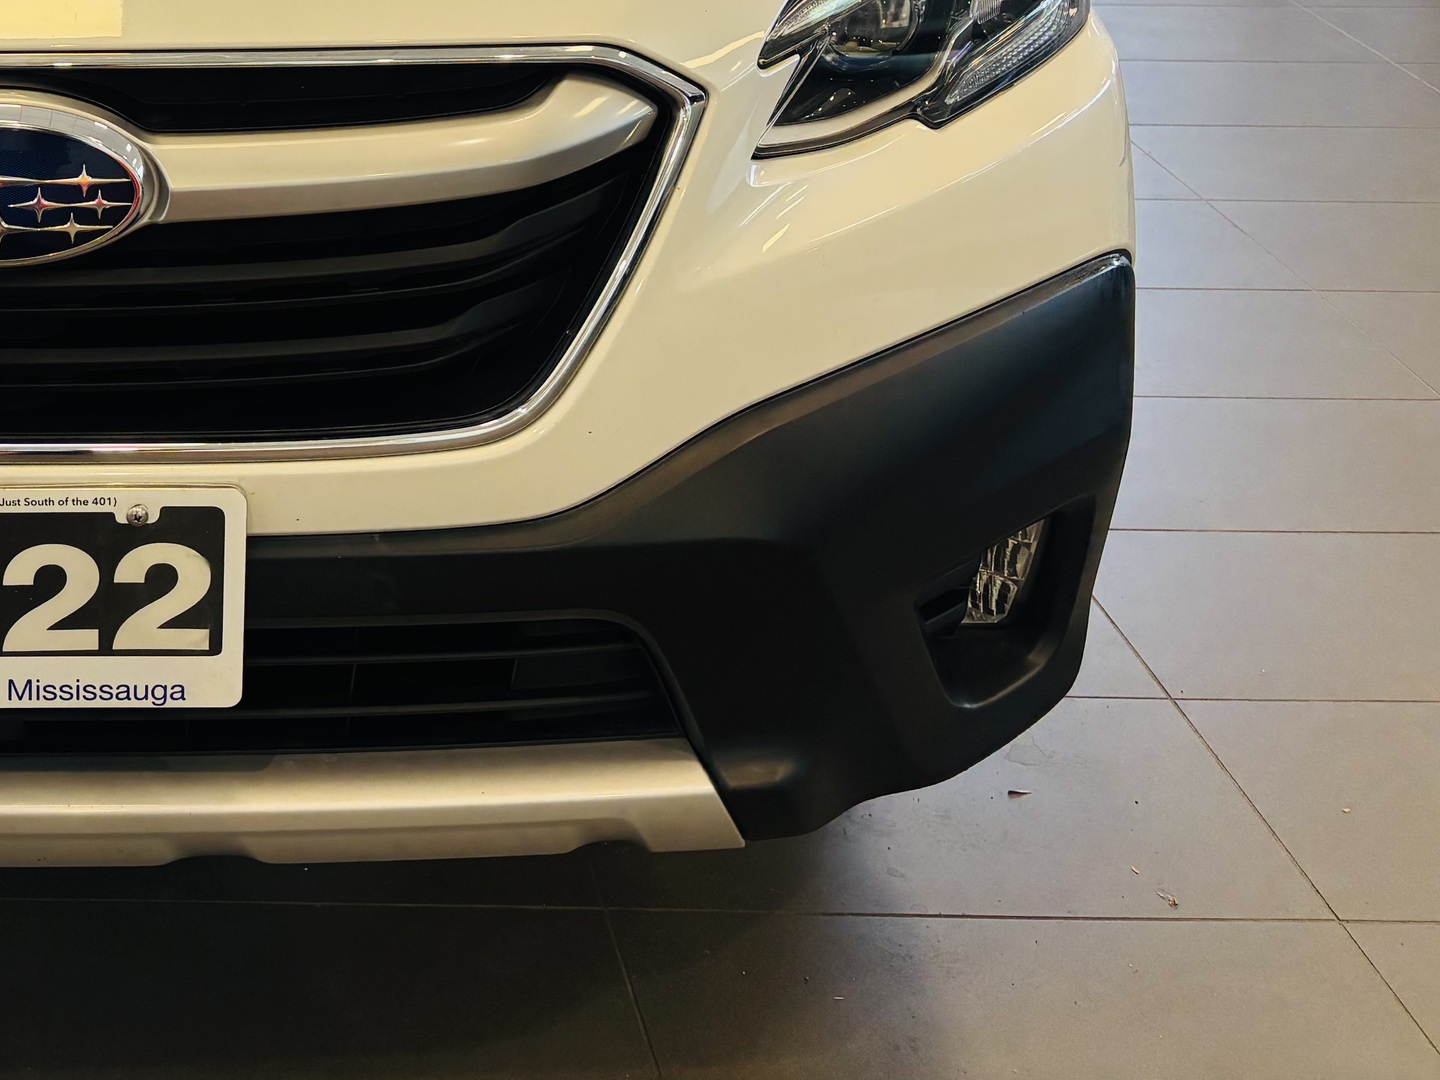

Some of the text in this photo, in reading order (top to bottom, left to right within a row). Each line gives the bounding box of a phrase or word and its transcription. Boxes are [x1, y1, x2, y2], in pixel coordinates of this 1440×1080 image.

[24, 497, 55, 507] South
[57, 497, 69, 506] of
[71, 497, 89, 506] the
[91, 496, 117, 507] 401)
[7, 678, 187, 707] Mississauga
